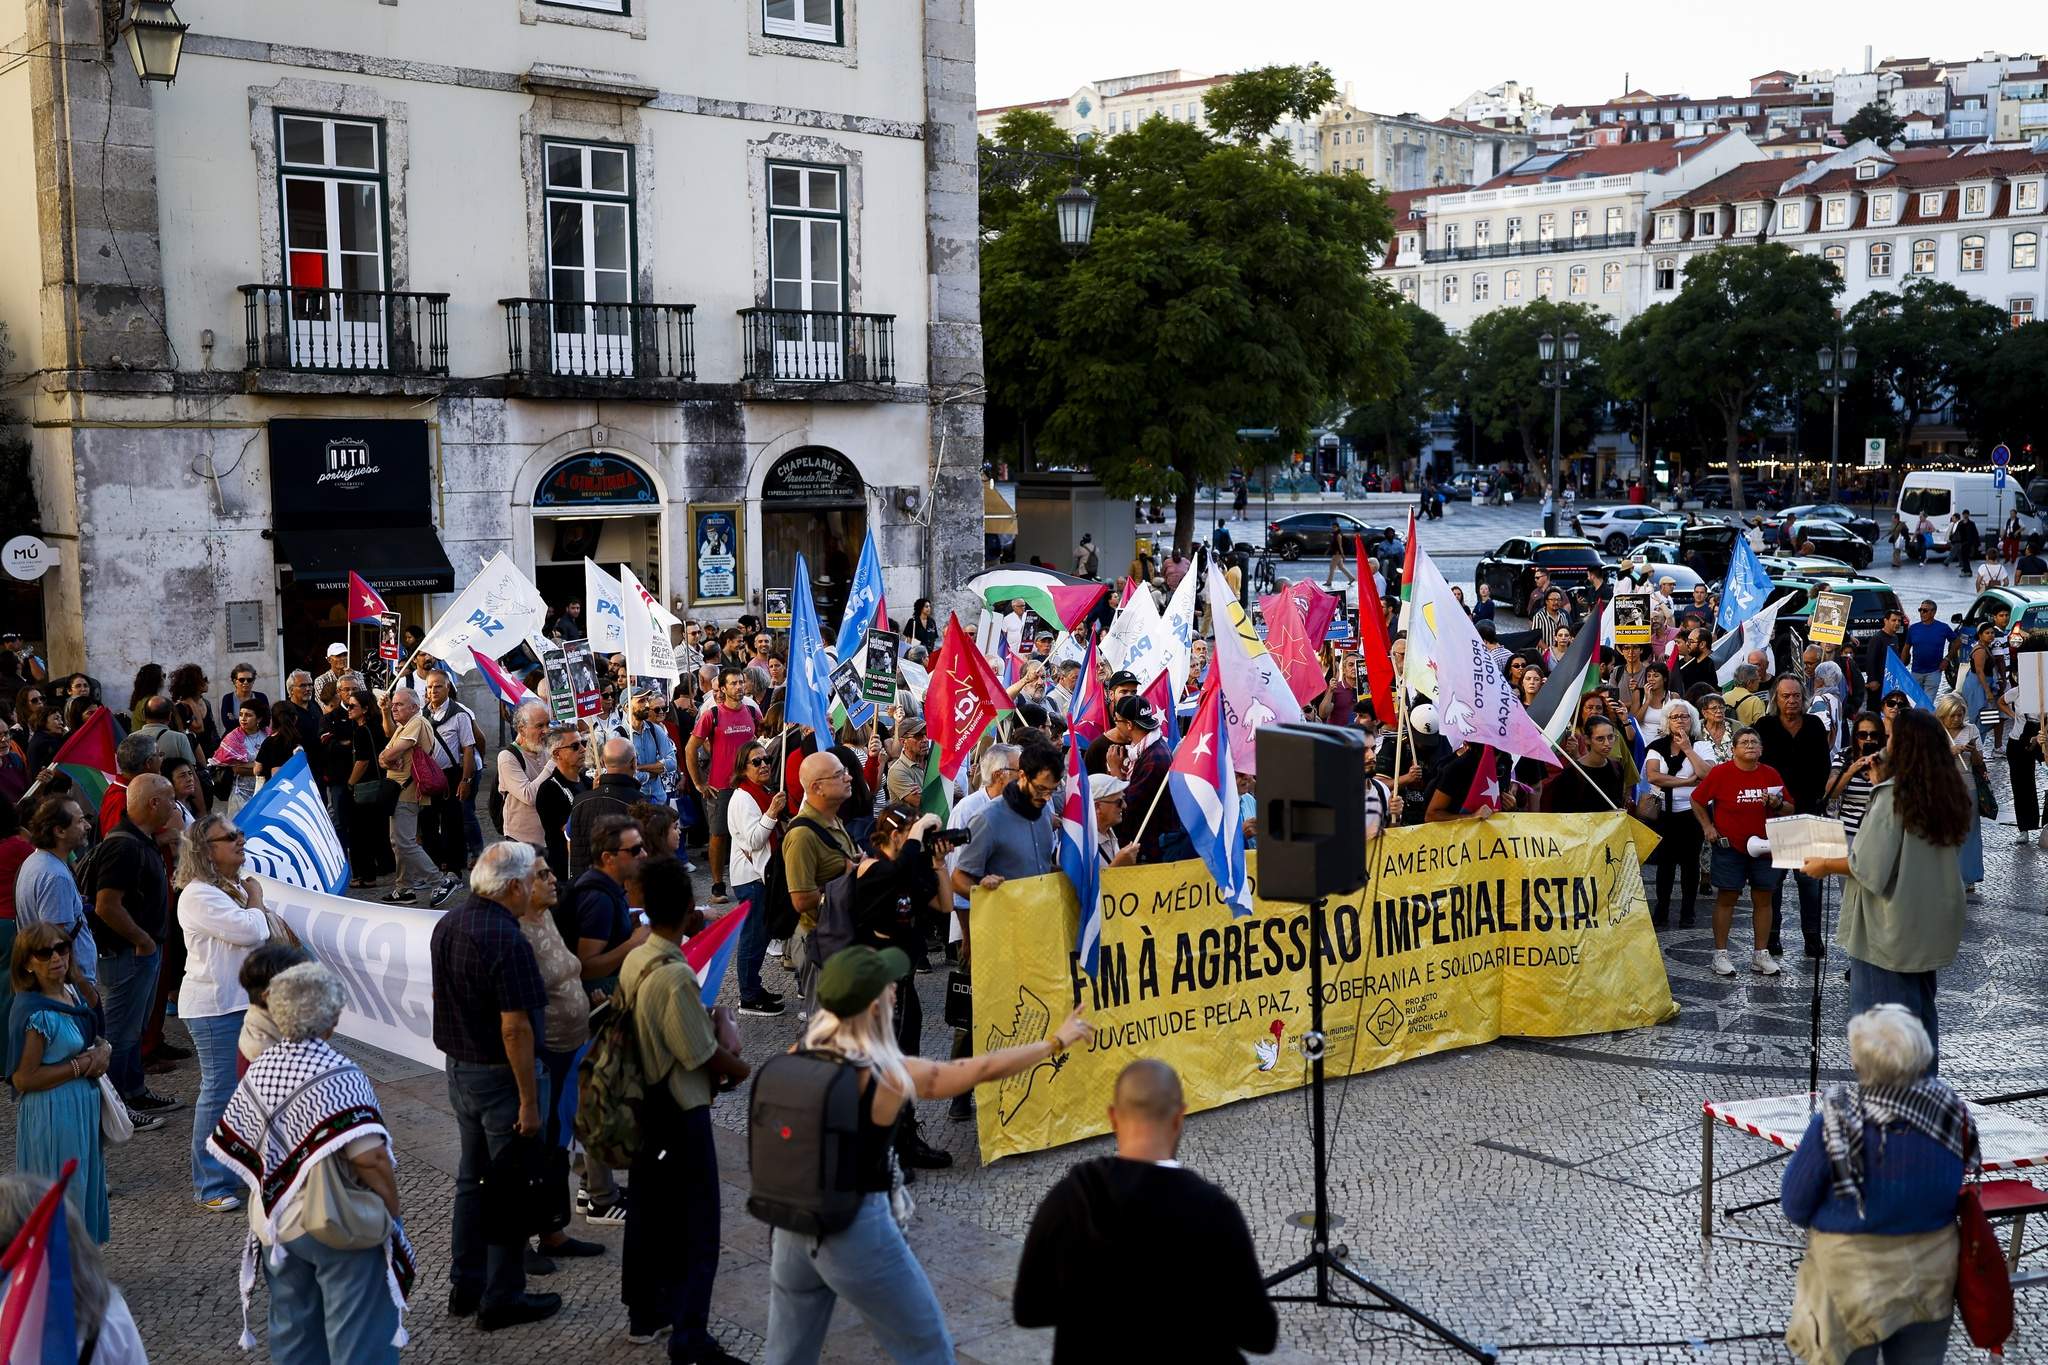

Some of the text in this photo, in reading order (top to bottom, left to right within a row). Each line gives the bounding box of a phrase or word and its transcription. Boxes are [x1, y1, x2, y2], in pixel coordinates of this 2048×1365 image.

[330, 449, 366, 470] NATA
[777, 457, 843, 477] CHAPELARIAS
[317, 465, 380, 484] portuguesa
[1995, 473, 2004, 486] P
[14, 543, 38, 560] MÚ
[316, 582, 350, 590] TRADITIO
[596, 598, 624, 622] PA
[466, 608, 505, 638] PAZ
[651, 645, 661, 653] DO
[1103, 892, 1139, 920] DO
[1383, 842, 1471, 878] AMÉRICA
[1479, 836, 1562, 860] LATINA
[1070, 876, 1599, 1012] FIM À AGRESSÃO IMPERIALISTA!
[1088, 945, 1580, 1053] JUVENTUDE PELA PAZ, SOBERANIA E SOLIDARIEDADE
[1405, 993, 1438, 1006] PROJECTO
[1405, 1004, 1427, 1015] RUÍDO
[1408, 1011, 1448, 1026] ASSOCIAÇÃO
[1408, 1024, 1434, 1035] JUVENIL
